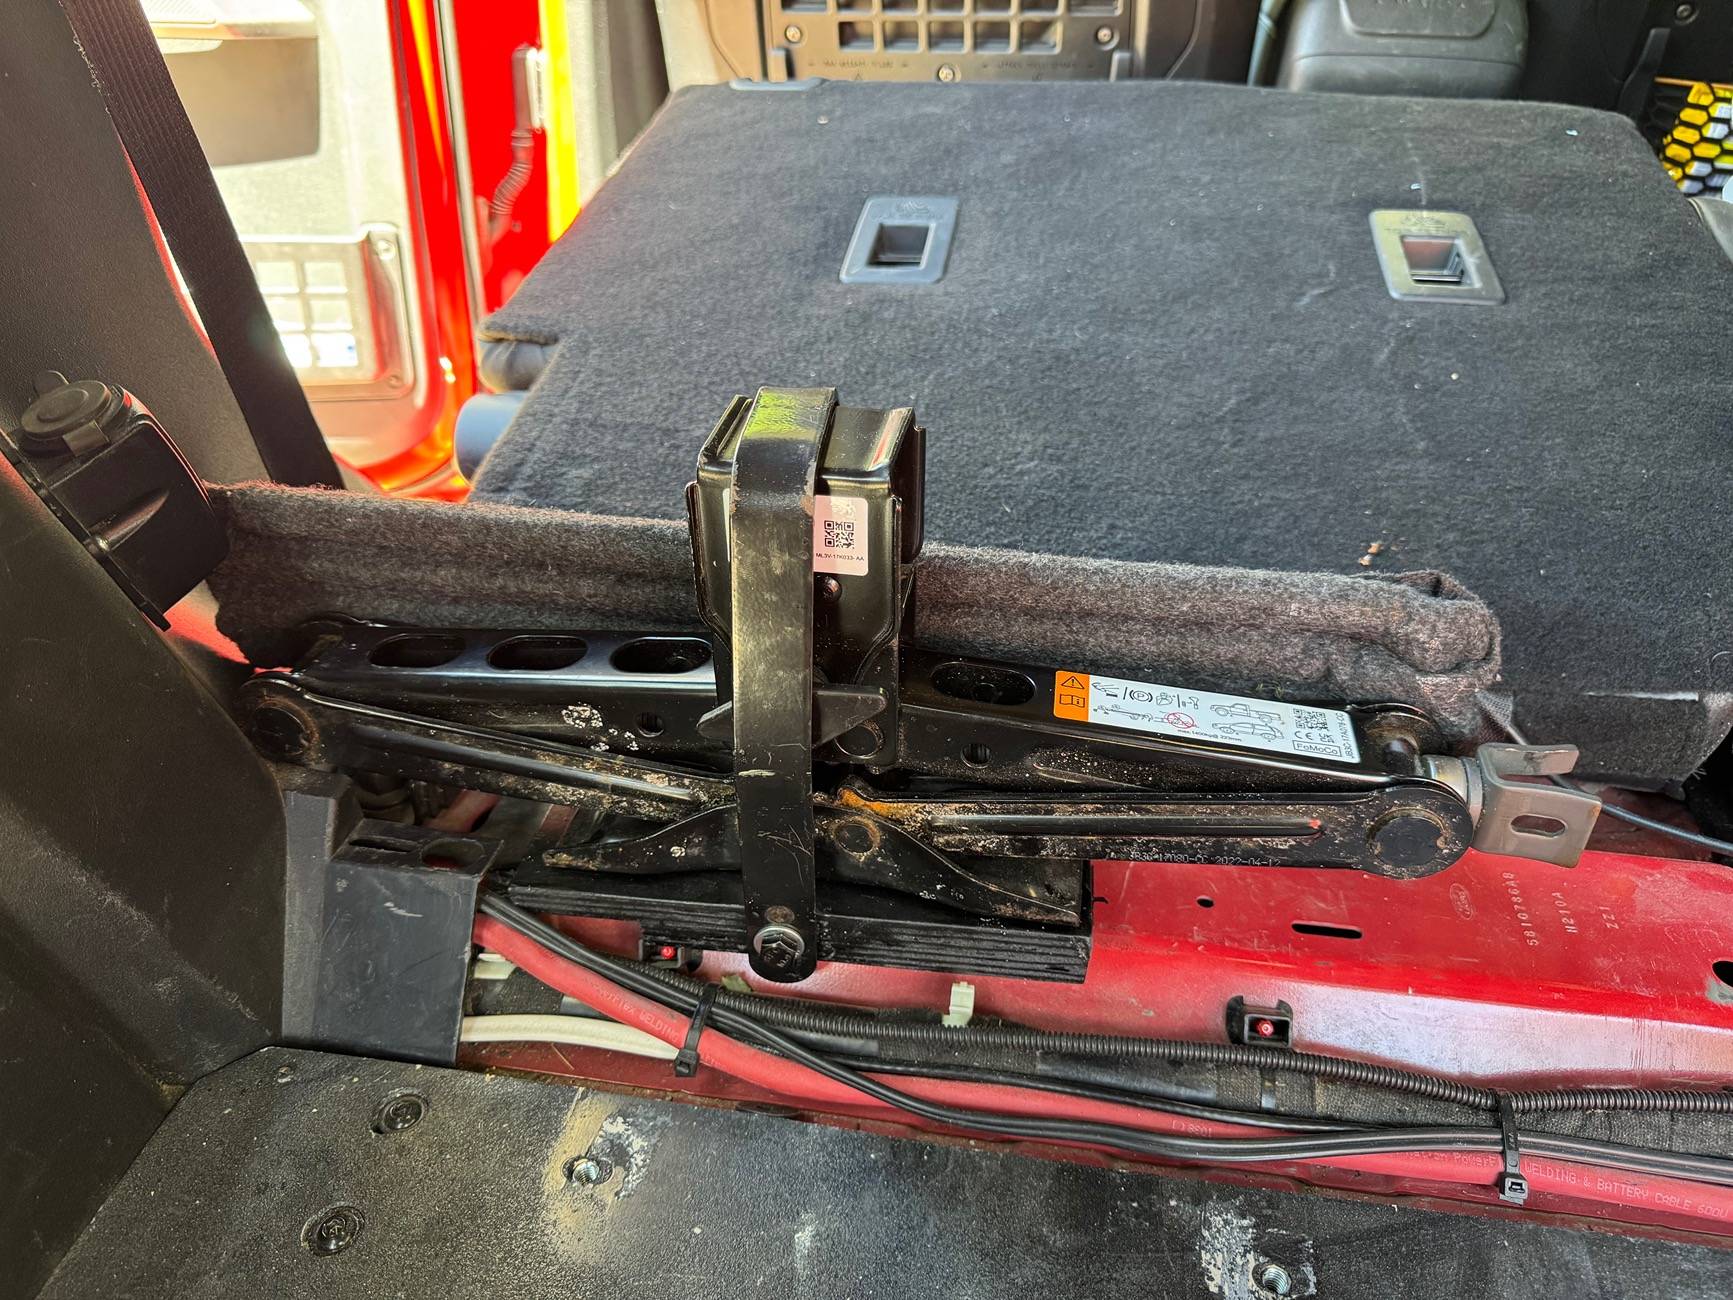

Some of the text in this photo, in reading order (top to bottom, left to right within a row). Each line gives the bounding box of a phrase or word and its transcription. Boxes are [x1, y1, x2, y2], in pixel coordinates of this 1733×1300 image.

[1296, 742, 1338, 755] FoMoCo
[639, 1010, 679, 1043] WELDING
[1525, 1160, 1577, 1185] WELDING
[1583, 1175, 1591, 1188] &
[1597, 1178, 1649, 1200] BATTERY
[1655, 1192, 1693, 1211] CABLE
